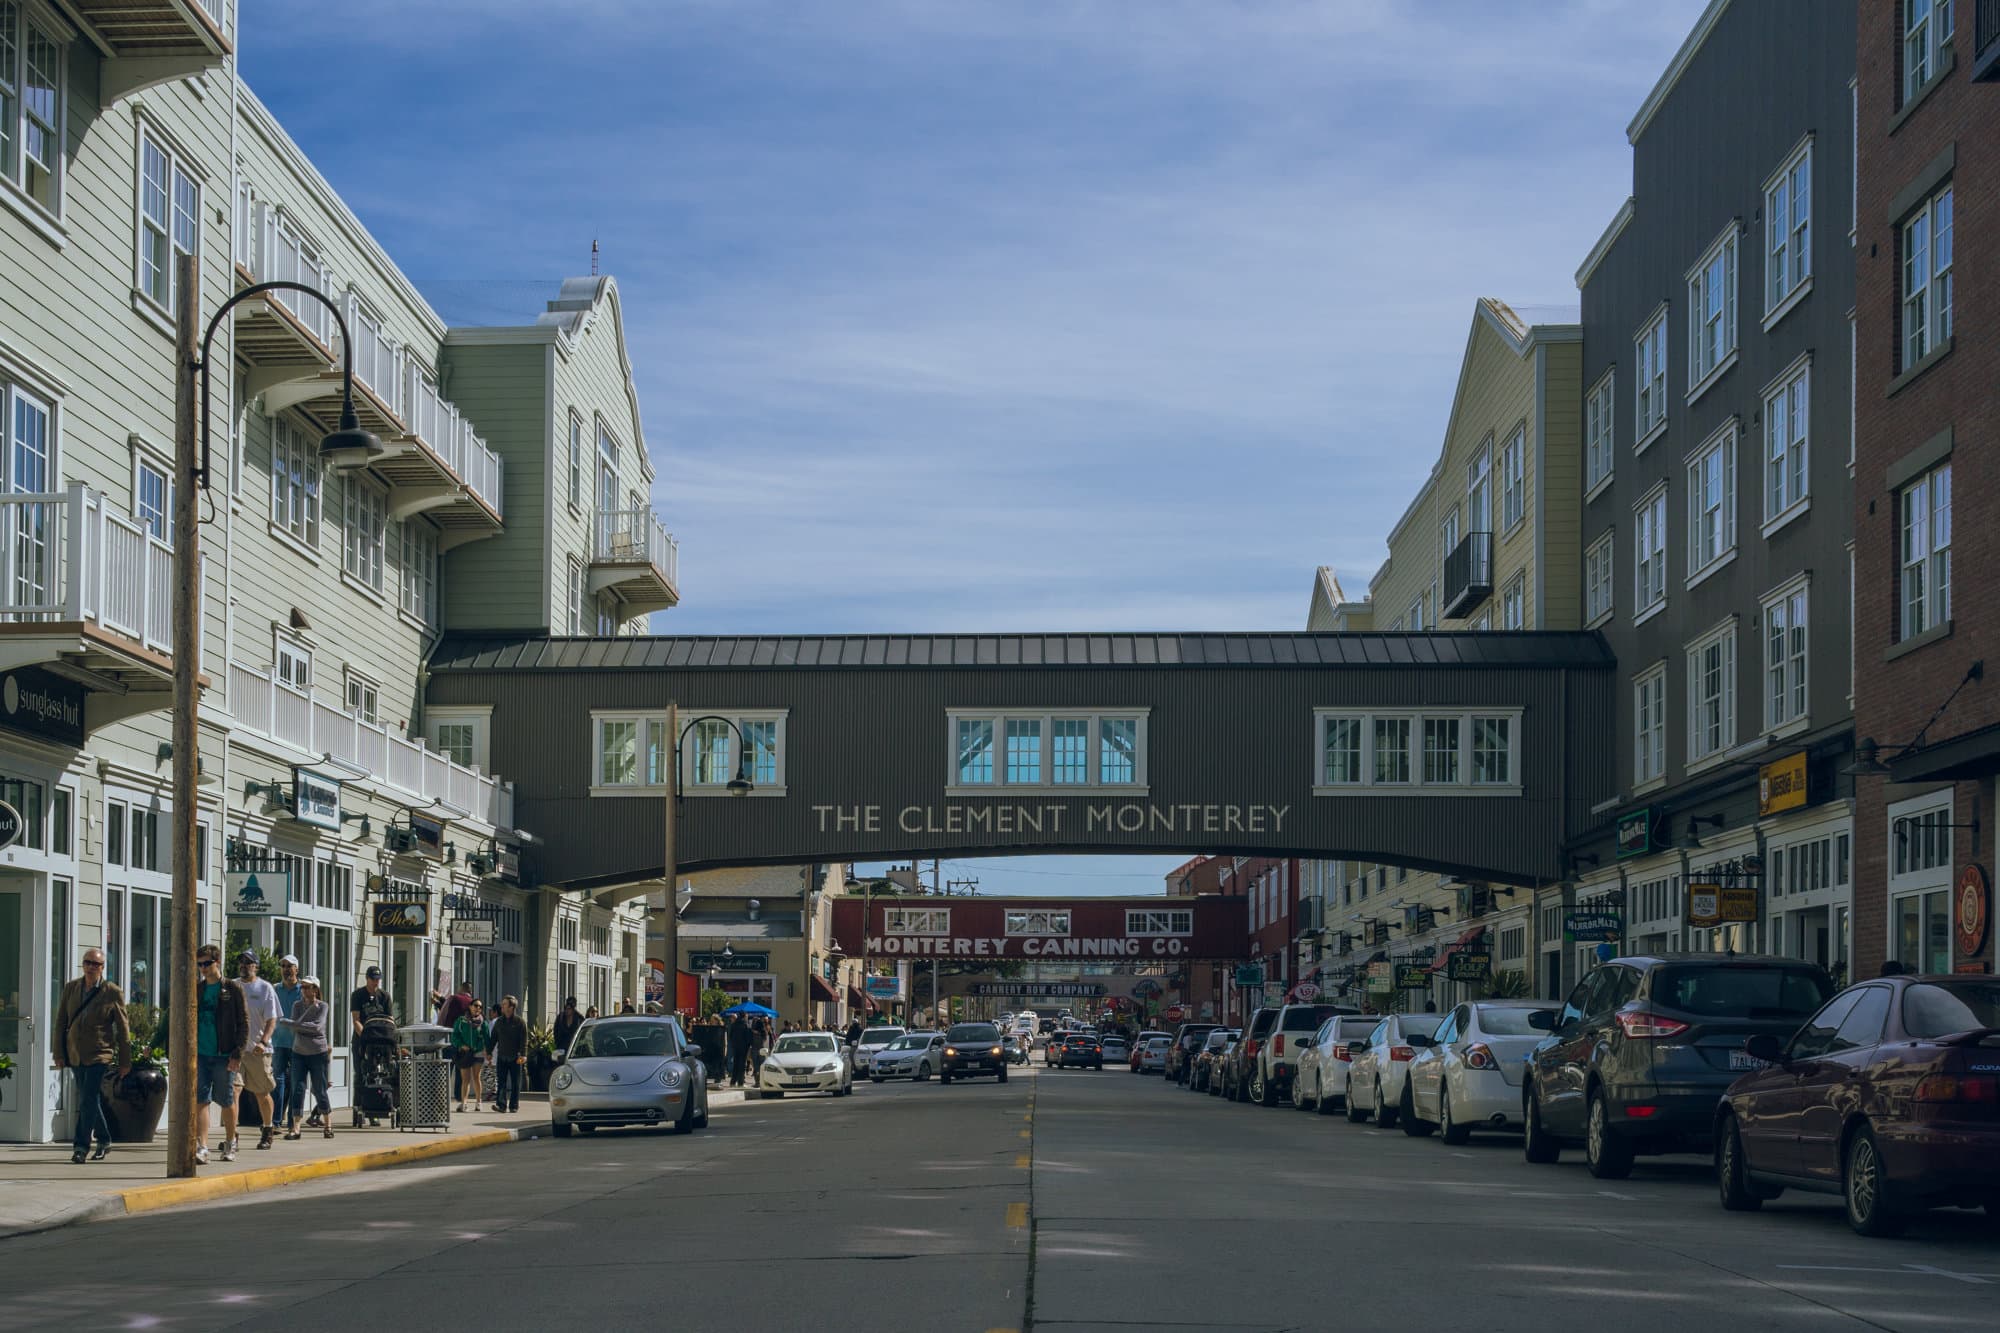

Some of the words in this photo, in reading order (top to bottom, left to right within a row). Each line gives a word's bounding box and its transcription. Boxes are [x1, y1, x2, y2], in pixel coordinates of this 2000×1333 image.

[20, 688, 62, 721] sunglass
[63, 696, 79, 726] hut
[812, 805, 881, 832] THE
[899, 805, 1067, 832] CLEMENT
[1087, 804, 1290, 832] MONTEREY
[867, 937, 1008, 955] MONTEREY
[1023, 938, 1140, 955] CANNING
[1152, 938, 1190, 954] CO.
[980, 984, 1021, 995] CANNERY
[1026, 984, 1047, 994] ROW
[1051, 984, 1096, 995] COMPANY
